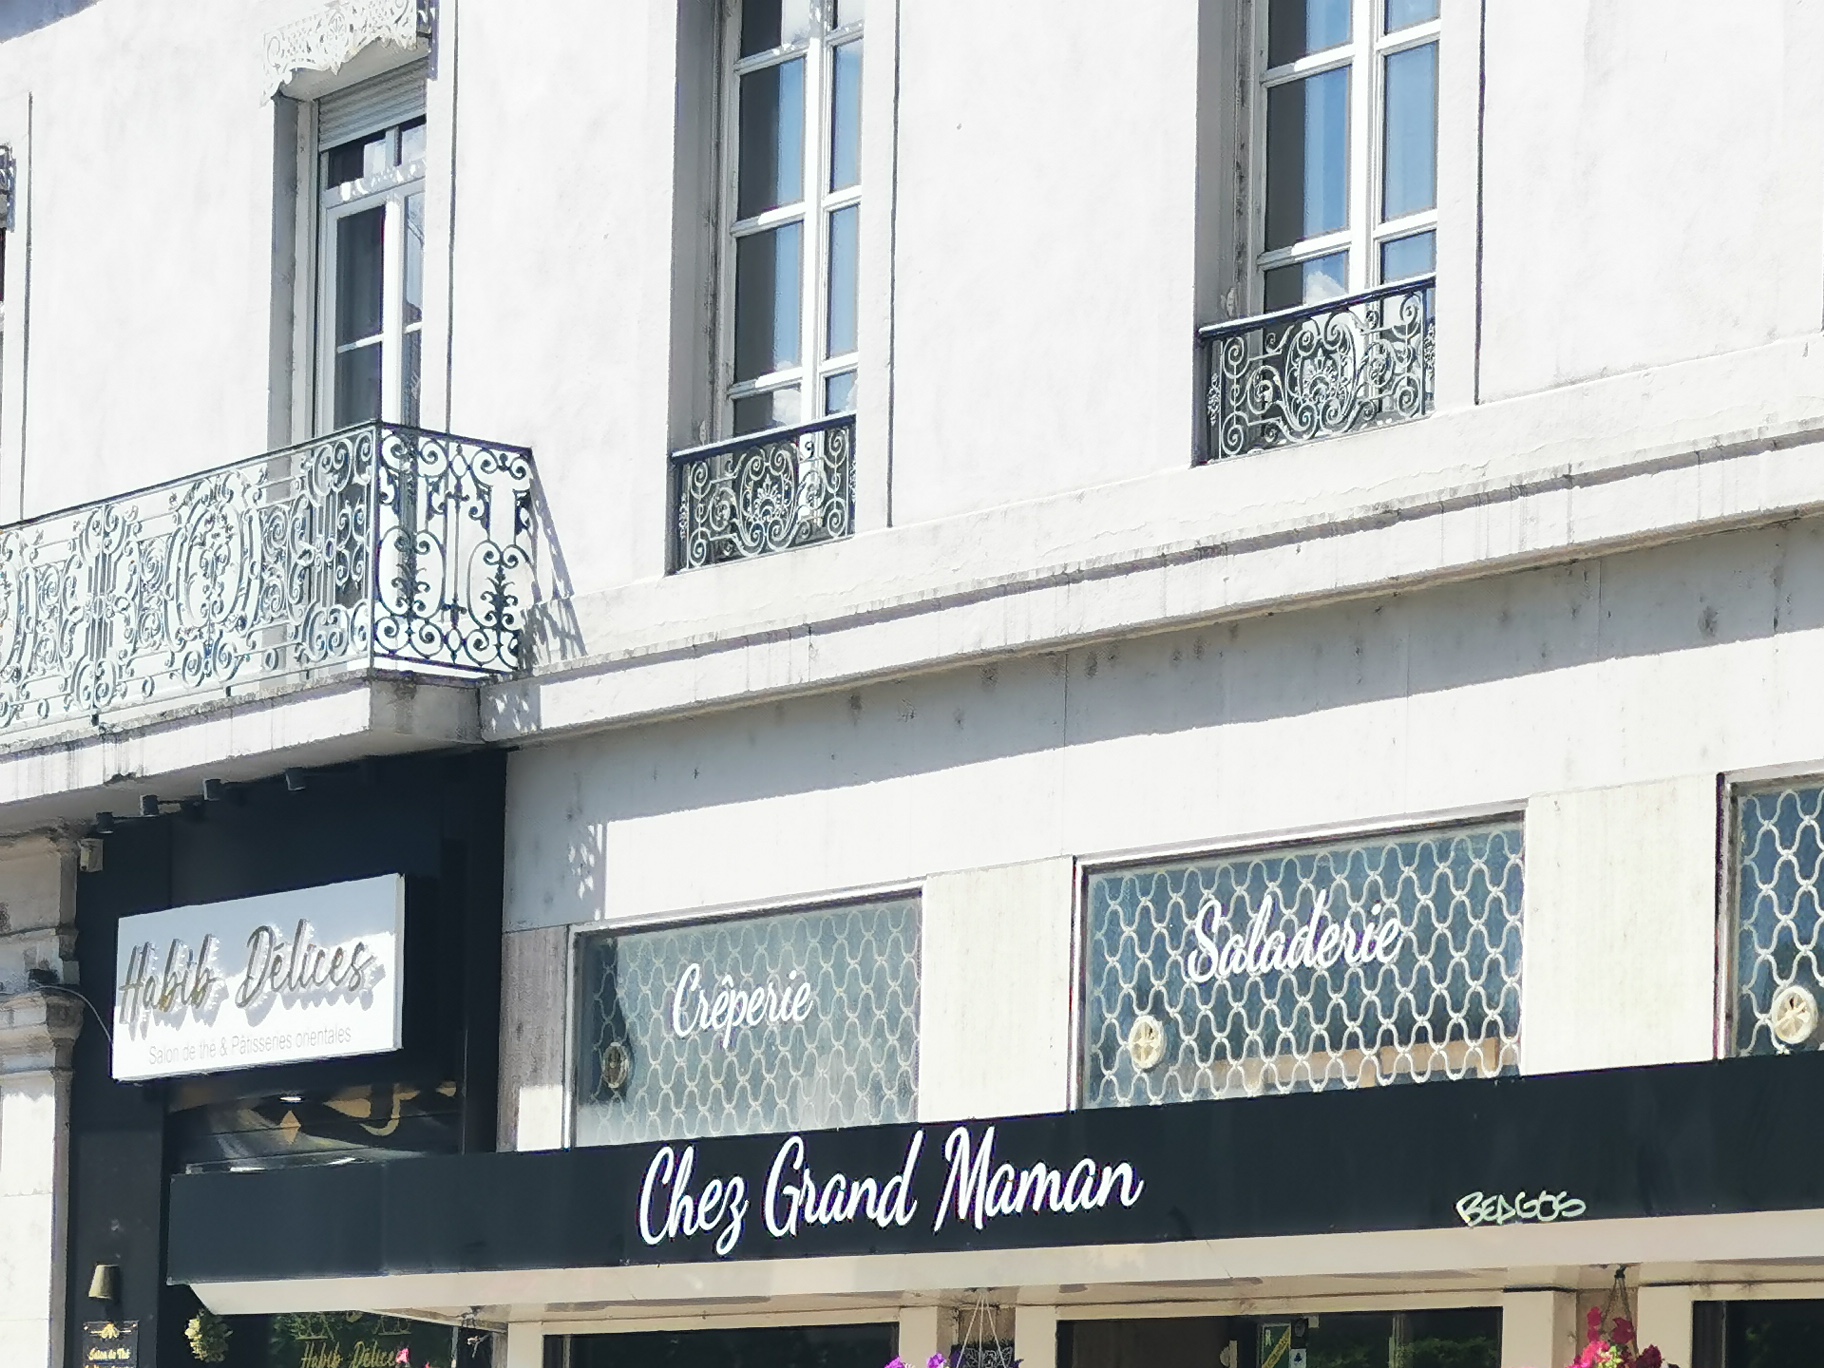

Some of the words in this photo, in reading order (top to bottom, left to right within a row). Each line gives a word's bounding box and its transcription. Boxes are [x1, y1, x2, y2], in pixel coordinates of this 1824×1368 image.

[119, 934, 226, 1024] Habib
[236, 919, 377, 1010] Délices
[1187, 889, 1401, 983] Saladerie
[673, 963, 814, 1048] Crêperie
[149, 1044, 179, 1066] Salon
[219, 1040, 228, 1057] &
[637, 1144, 748, 1256] Chez
[764, 1129, 924, 1239] Grand
[934, 1125, 1144, 1233] Maman
